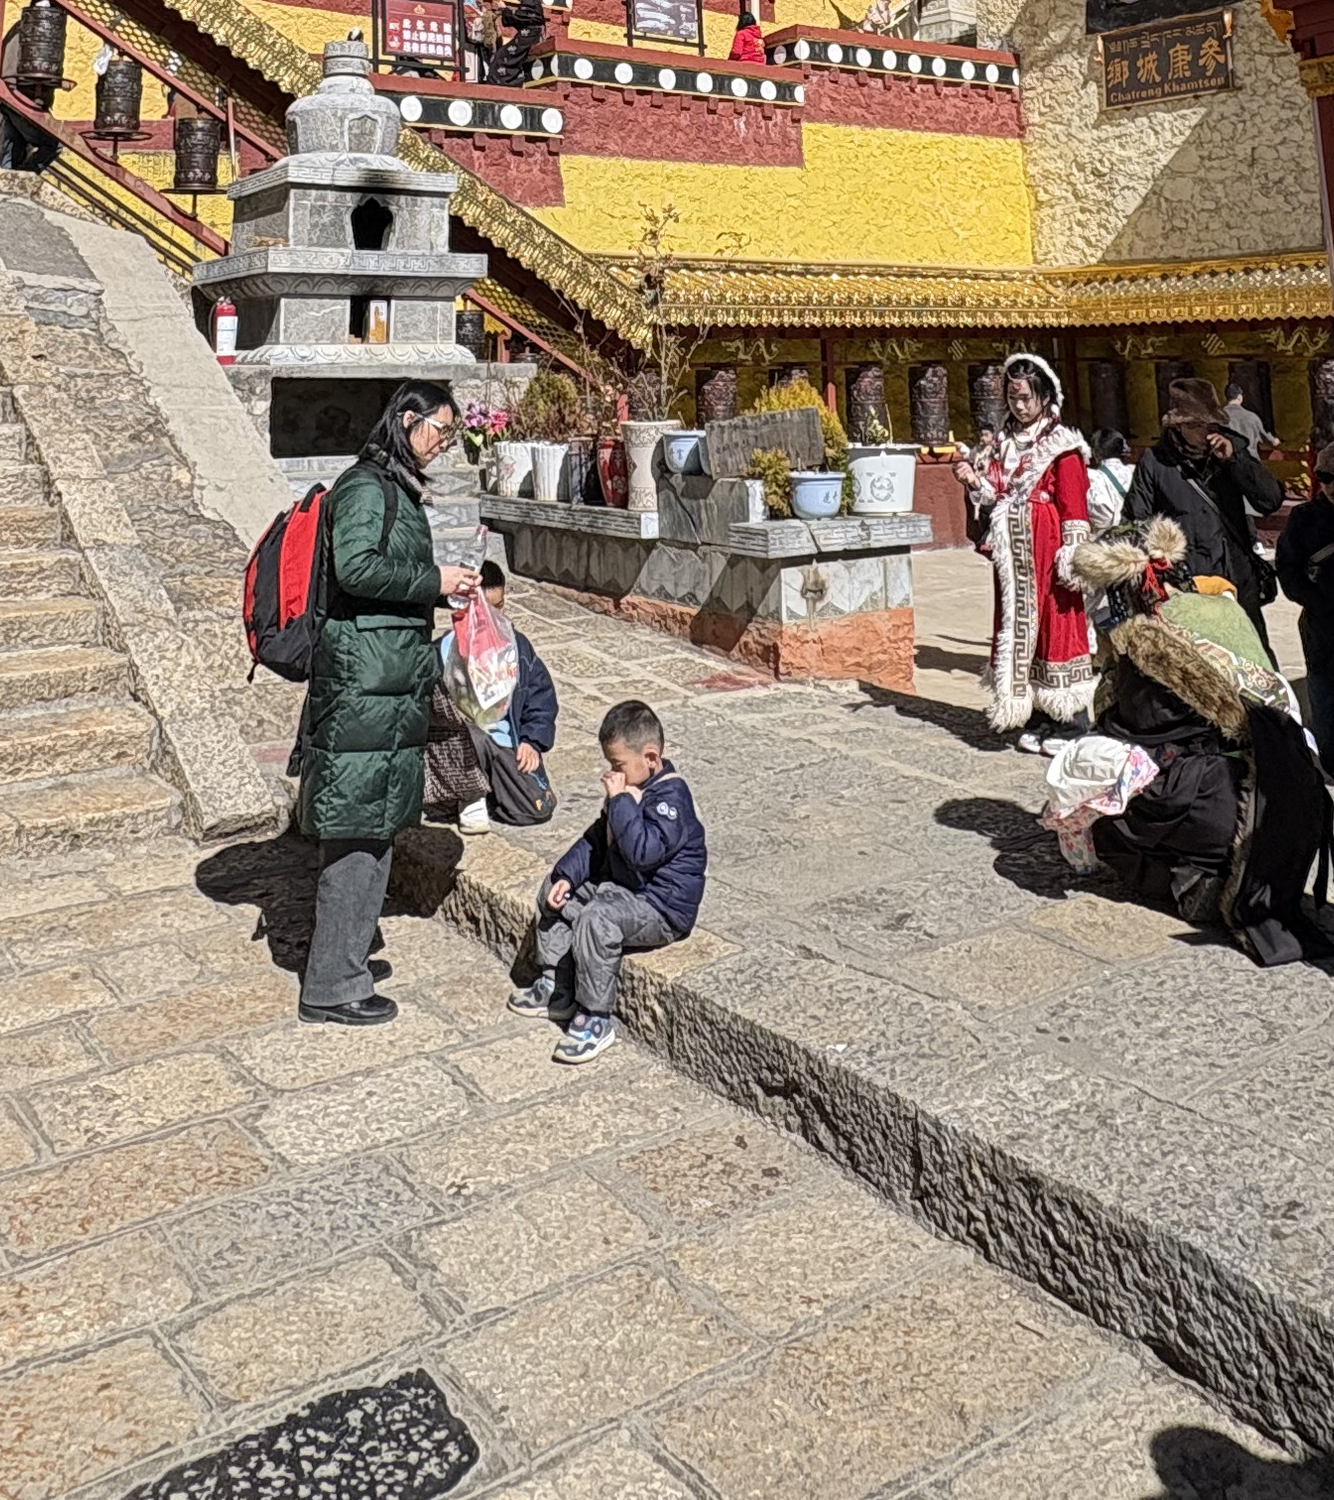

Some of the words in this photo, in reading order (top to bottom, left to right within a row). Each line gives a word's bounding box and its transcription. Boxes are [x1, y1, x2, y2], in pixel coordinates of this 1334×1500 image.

[1107, 36, 1225, 88] 鄉城康參
[1110, 85, 1163, 104] Chatreng
[1164, 75, 1225, 94] Khamtsen
